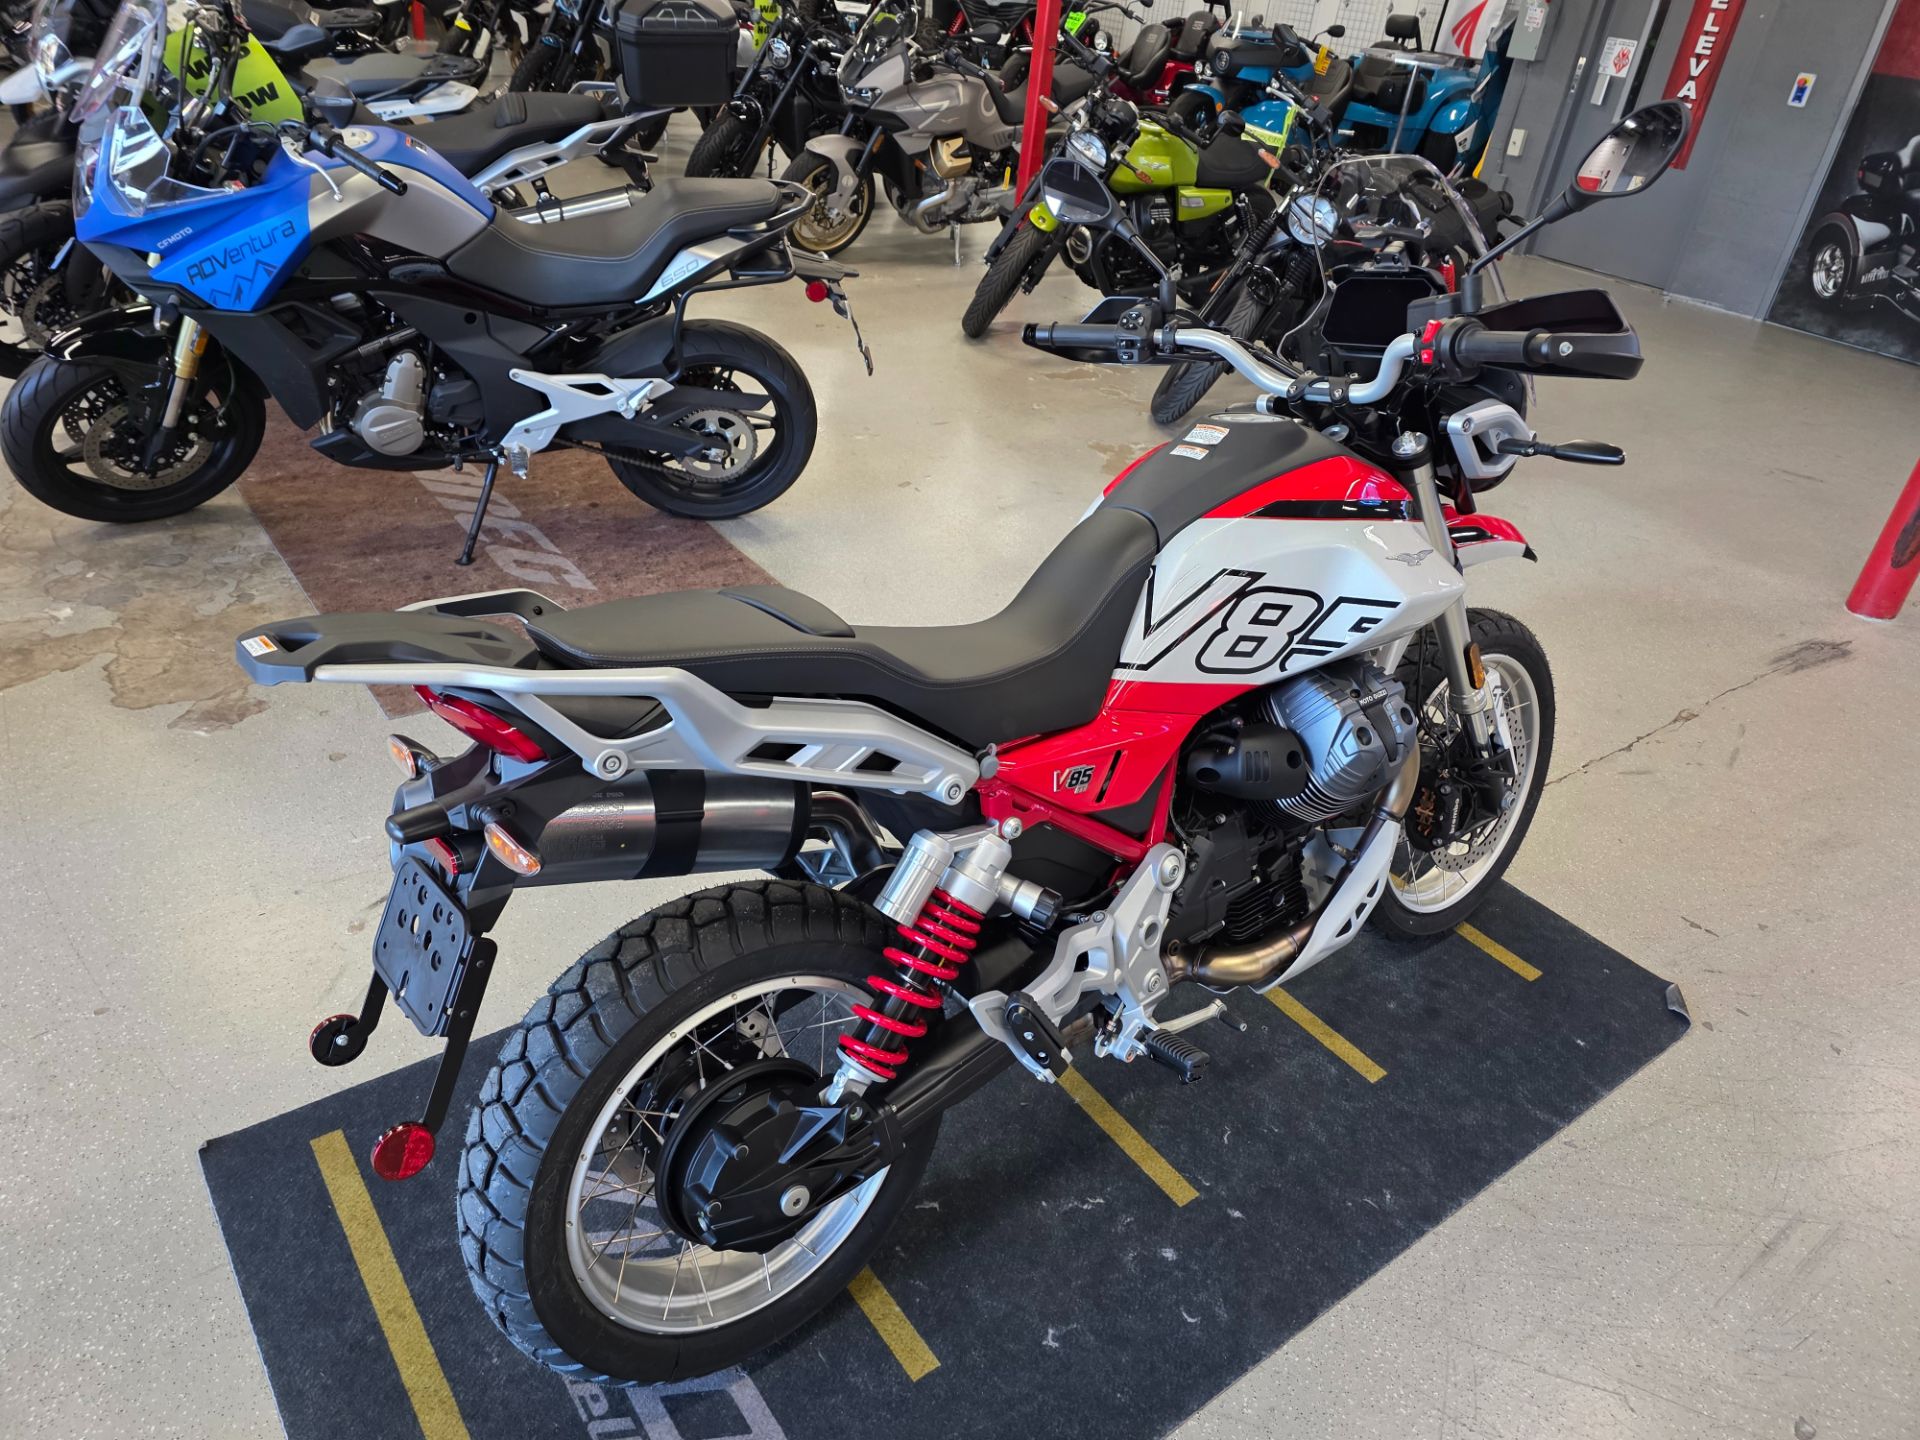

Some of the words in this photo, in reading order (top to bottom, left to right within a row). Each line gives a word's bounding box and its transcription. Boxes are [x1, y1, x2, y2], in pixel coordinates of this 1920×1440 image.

[1677, 0, 1729, 109] LEVA
[156, 226, 193, 250] CFMOTO
[661, 259, 699, 287] 650
